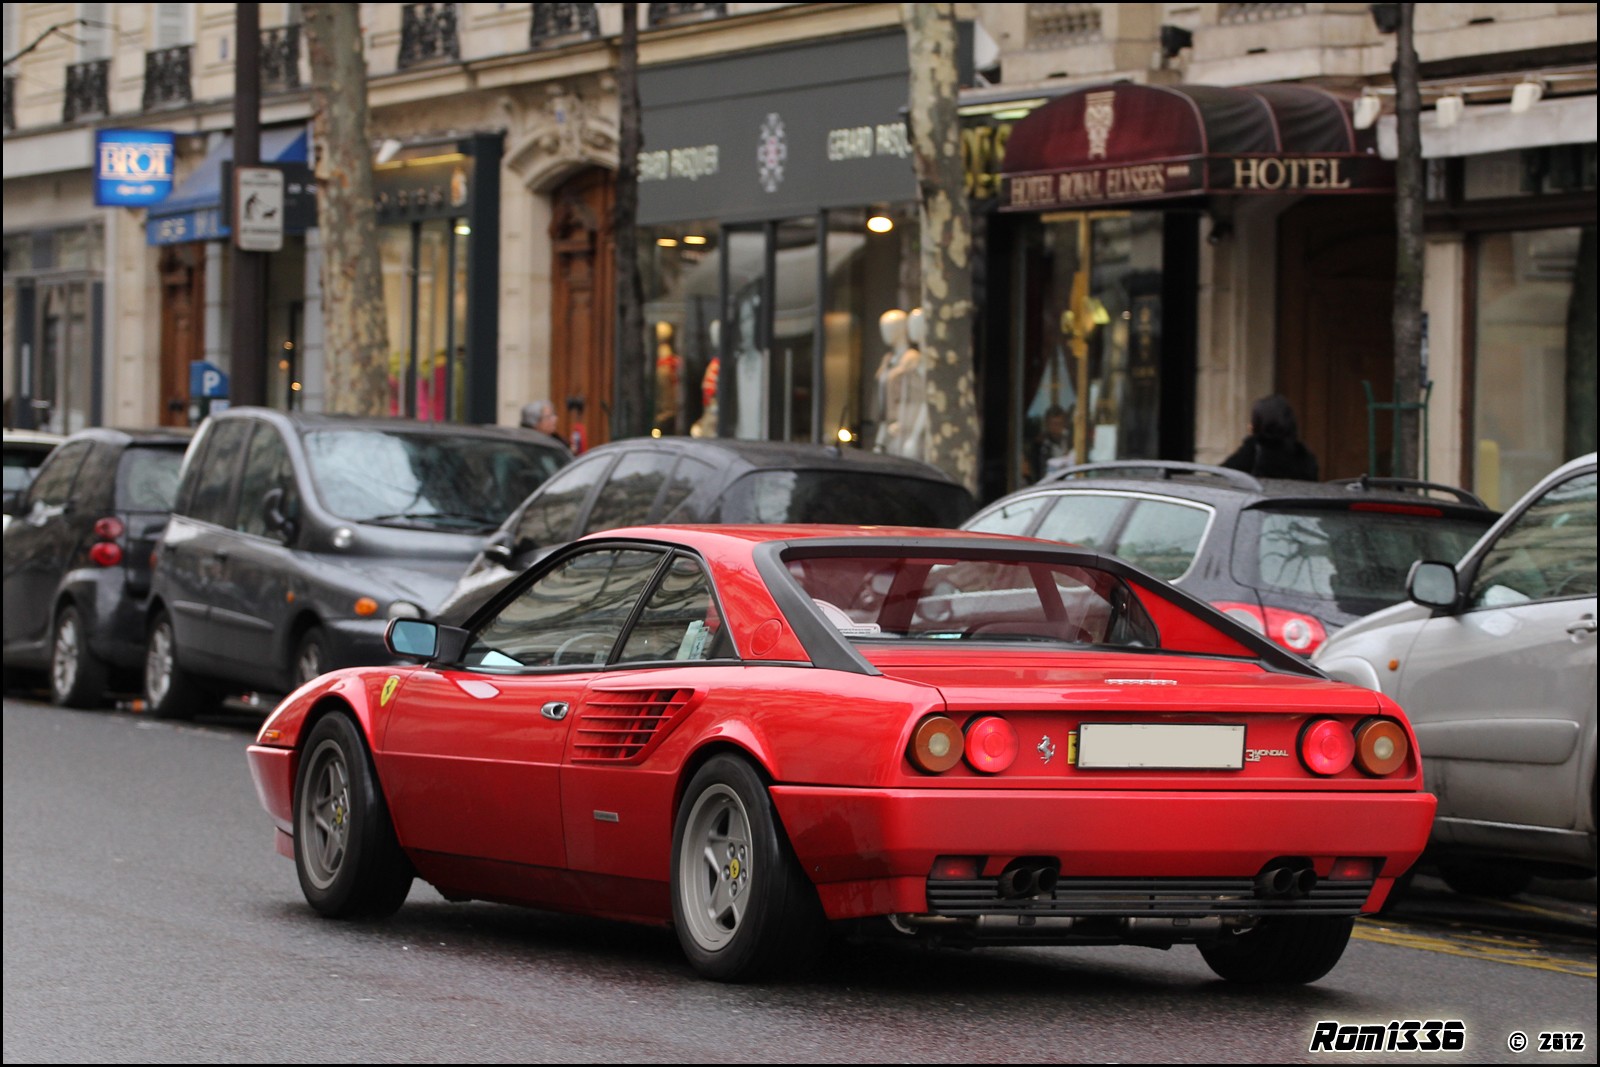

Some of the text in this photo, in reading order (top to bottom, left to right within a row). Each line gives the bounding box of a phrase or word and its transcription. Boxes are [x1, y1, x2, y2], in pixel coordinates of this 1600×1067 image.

[828, 127, 873, 160] GERARD
[1010, 163, 1166, 207] HOTEL ROYAL ELYSEES
[1233, 157, 1352, 190] HOTEL
[202, 370, 221, 396] P
